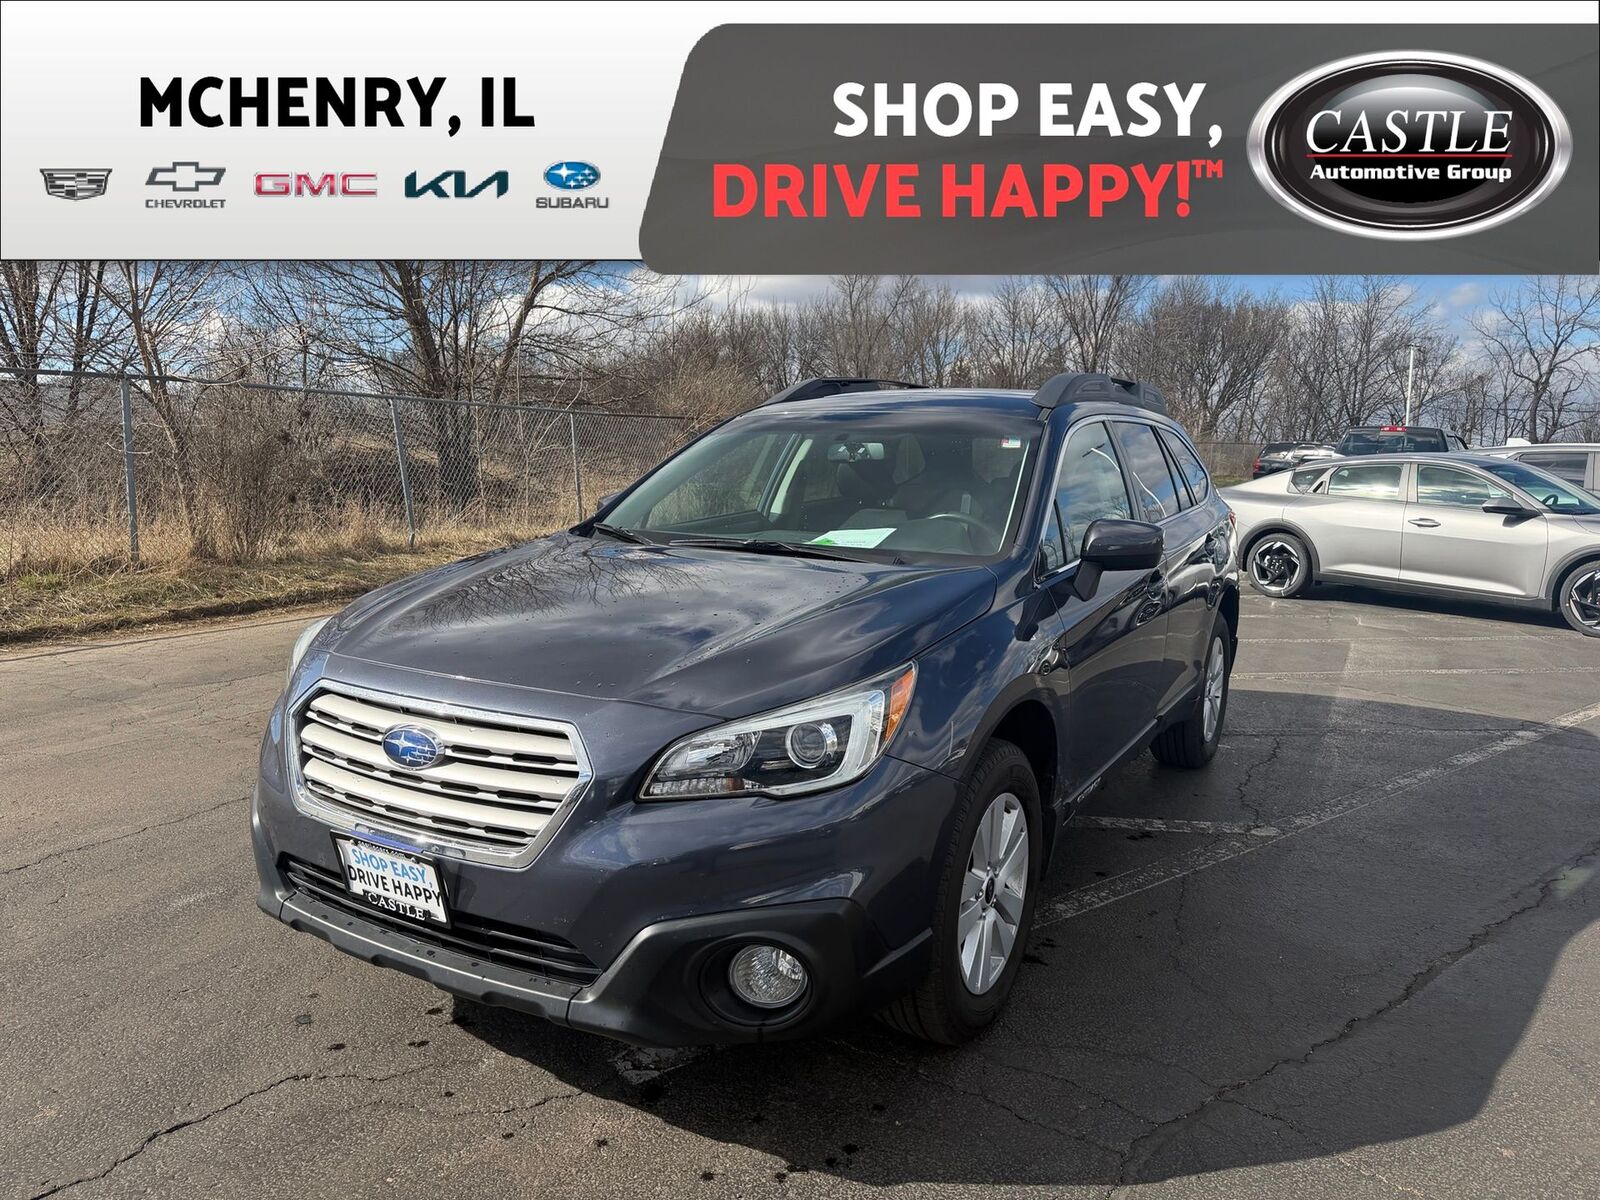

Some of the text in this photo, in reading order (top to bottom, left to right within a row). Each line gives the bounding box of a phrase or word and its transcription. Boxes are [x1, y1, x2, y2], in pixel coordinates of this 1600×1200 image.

[351, 848, 388, 873] SHOP
[347, 864, 441, 907] DRIVE HAPPY
[368, 892, 425, 920] CASTLE
